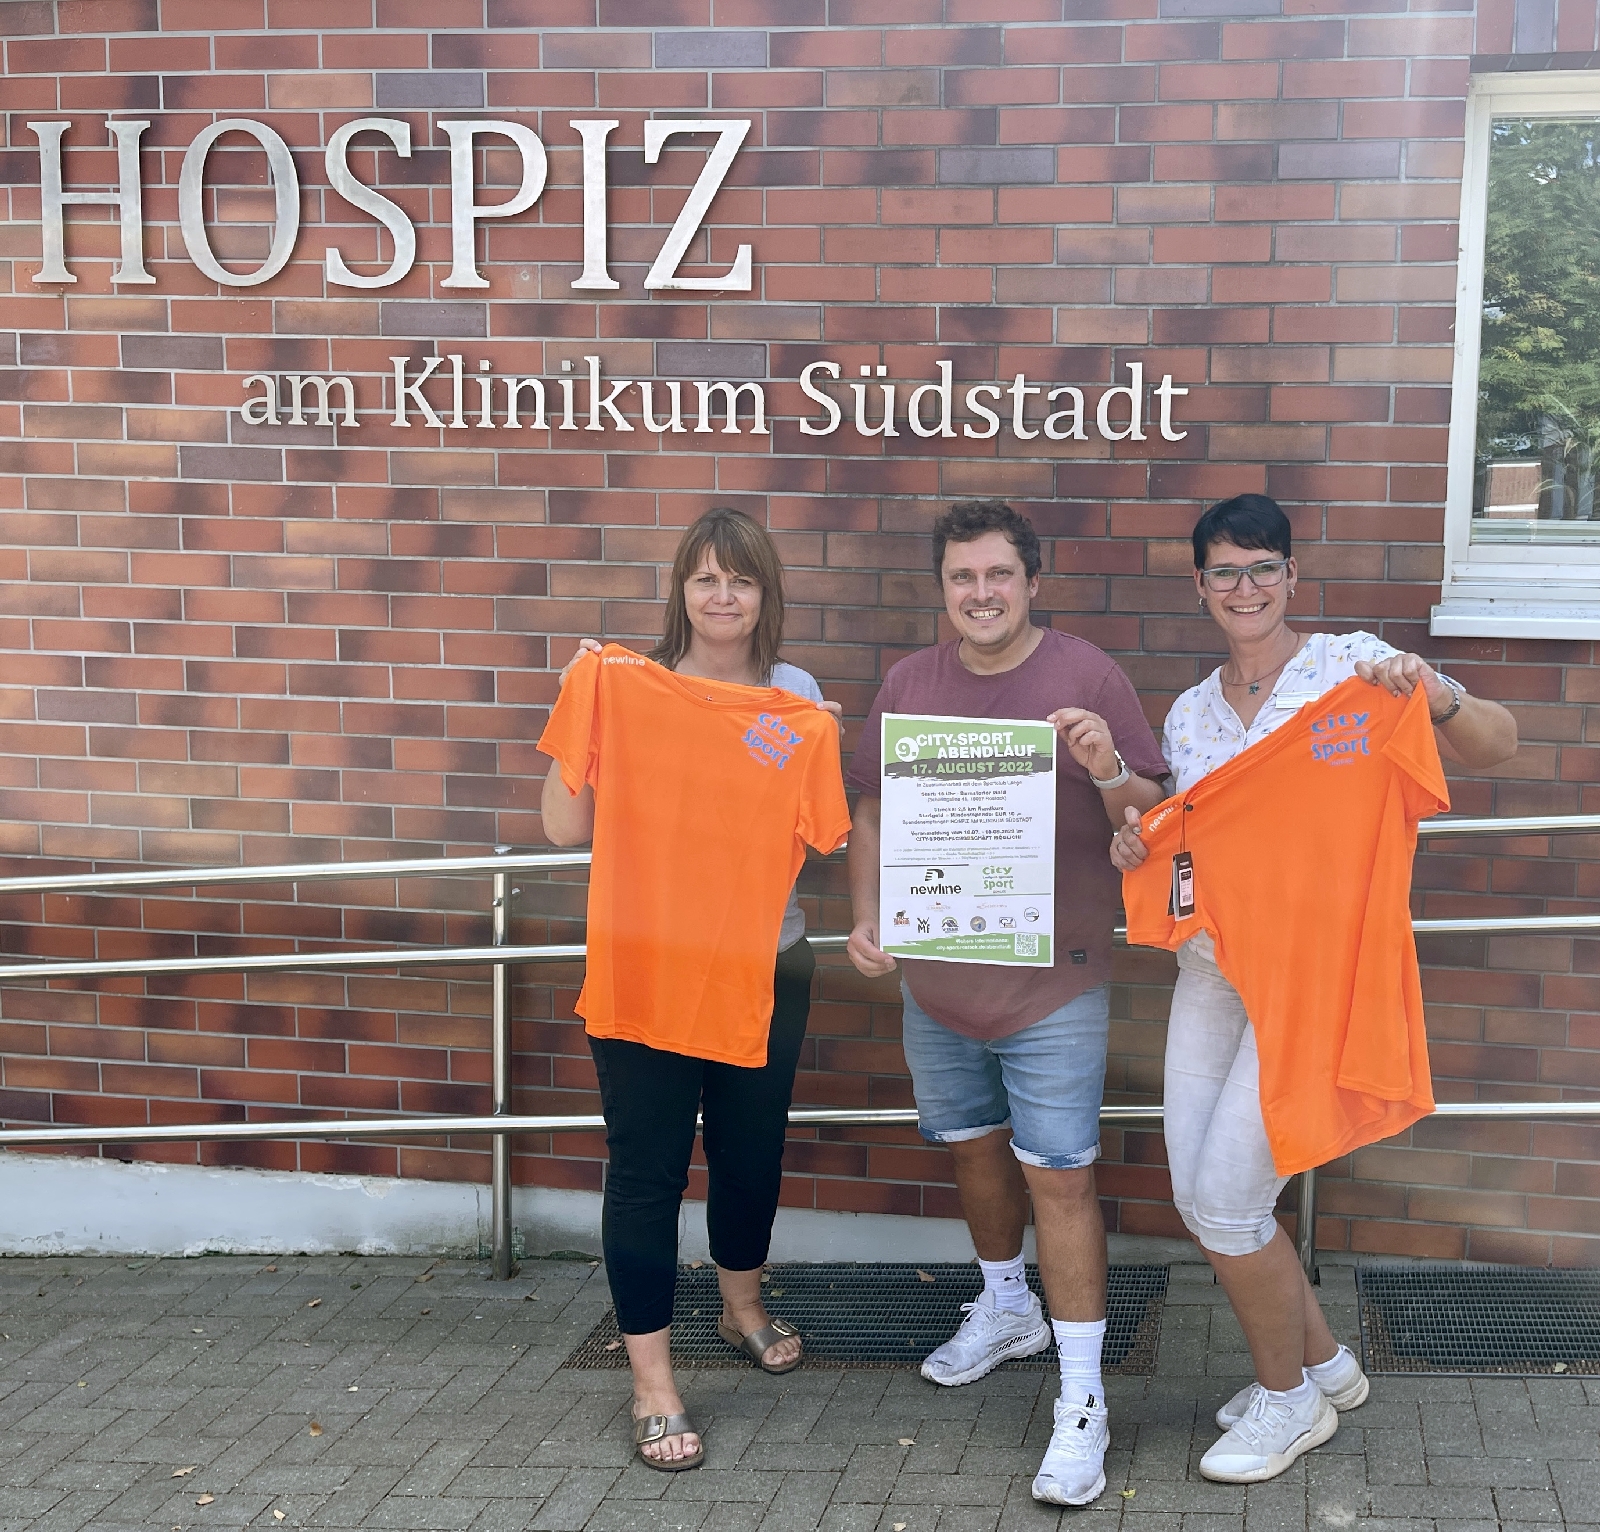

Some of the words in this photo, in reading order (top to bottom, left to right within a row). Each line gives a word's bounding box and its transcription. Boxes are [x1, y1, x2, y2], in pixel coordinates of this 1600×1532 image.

[26, 118, 752, 291] HOSPIZ
[240, 374, 360, 427] am
[389, 356, 769, 434] Klinikum
[799, 360, 1188, 441] Südstadt
[602, 655, 646, 667] newline
[937, 744, 1036, 759] ABENDLAUF
[911, 764, 932, 775] 17.
[936, 762, 995, 775] AUGUST
[999, 761, 1033, 773] 2022
[910, 884, 962, 895] newline
